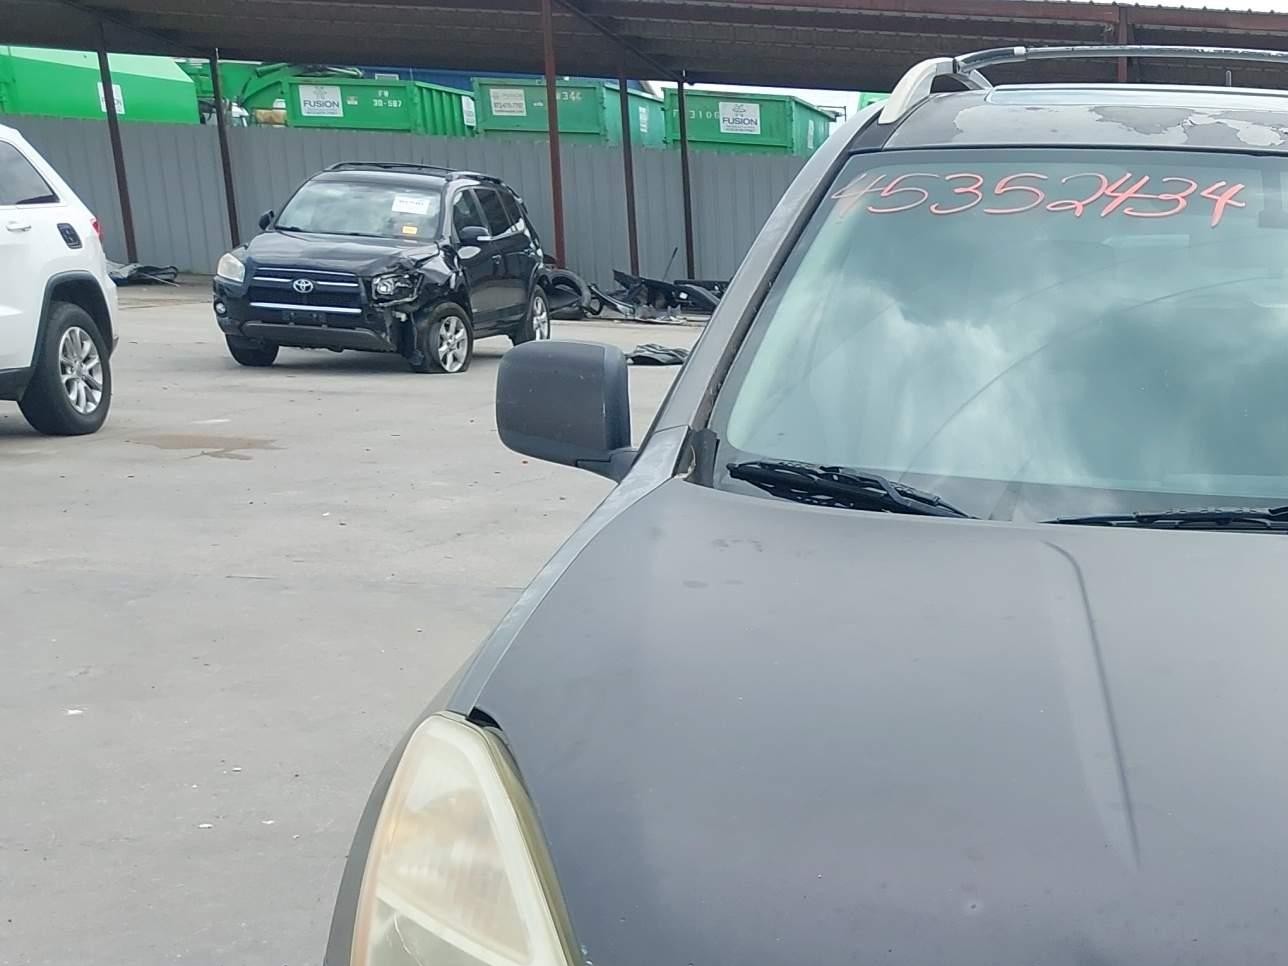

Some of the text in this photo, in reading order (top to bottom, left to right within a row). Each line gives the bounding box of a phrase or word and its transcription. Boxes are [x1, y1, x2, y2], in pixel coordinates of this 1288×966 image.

[303, 100, 340, 108] FUSION
[722, 117, 758, 126] FUSION
[832, 172, 1246, 227] 45352434
